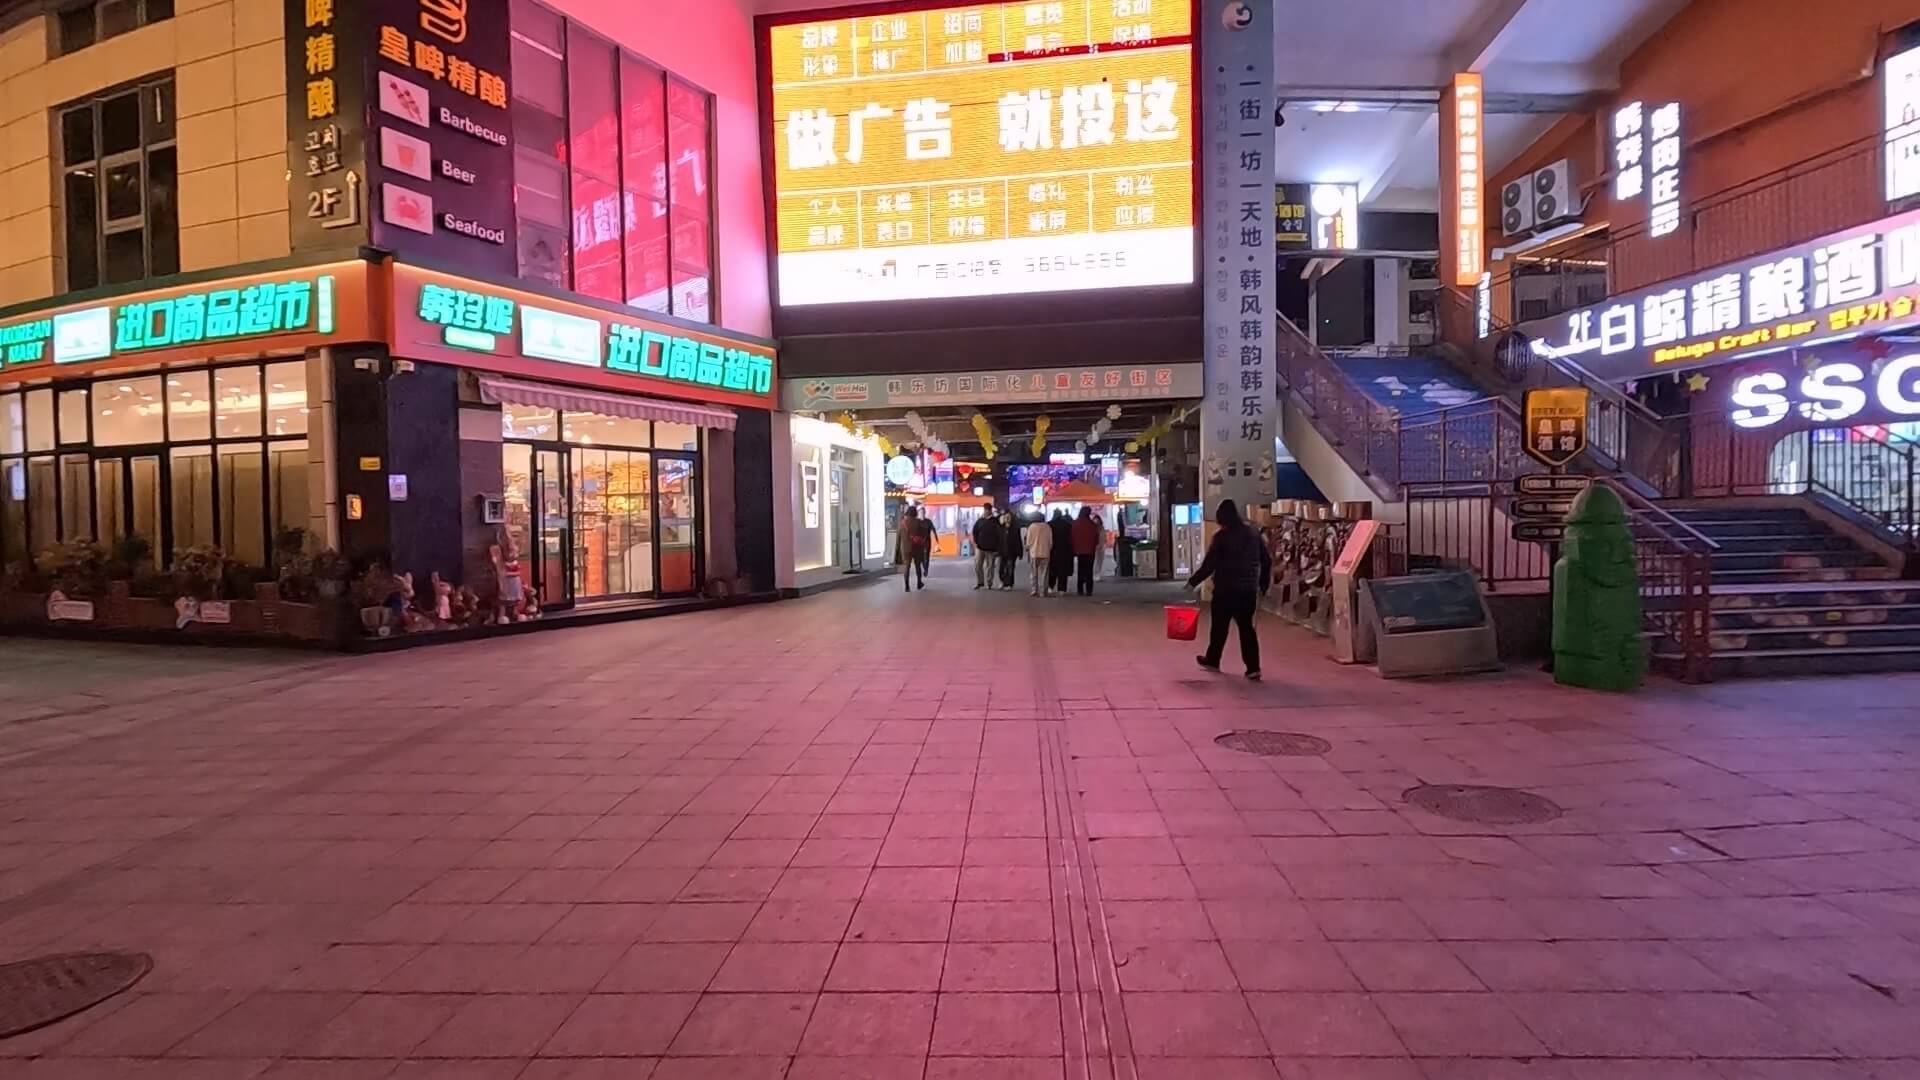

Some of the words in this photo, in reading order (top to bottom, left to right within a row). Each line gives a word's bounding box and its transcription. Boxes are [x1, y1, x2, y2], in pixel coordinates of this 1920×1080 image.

[379, 25, 507, 109] 皇啤精酿
[440, 107, 508, 146] Barbecue
[785, 98, 952, 169] 做广告
[998, 76, 1180, 151] 就投这
[442, 159, 477, 184] Beer
[307, 187, 340, 217] 2F
[444, 213, 506, 244] Seafood
[115, 280, 311, 349] 进口商品超市
[1568, 309, 1592, 345] 2F
[606, 322, 773, 393] 进口商品超市
[1655, 340, 1716, 363] Beluga
[1719, 325, 1773, 350] Craft
[1776, 320, 1818, 340] Bar
[887, 368, 1172, 395] 韩乐坊国际化儿童友好街区
